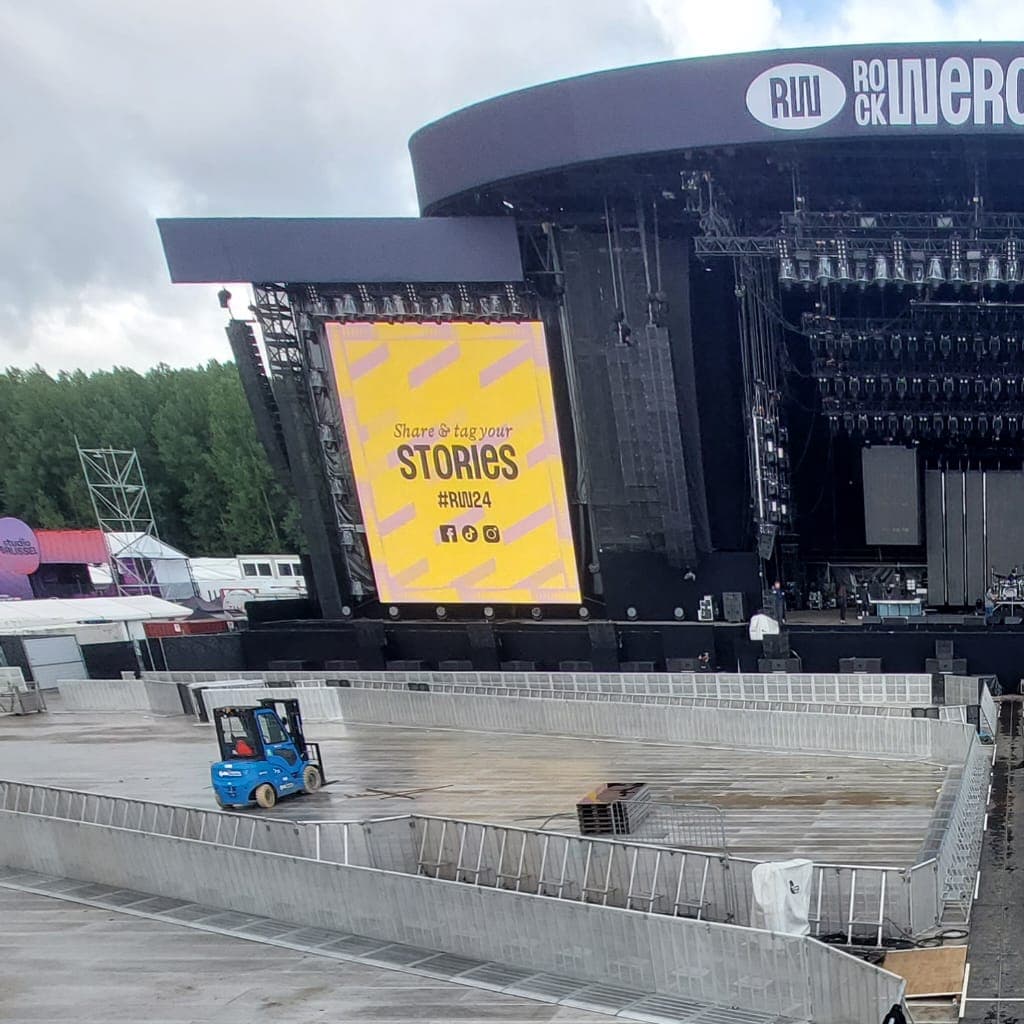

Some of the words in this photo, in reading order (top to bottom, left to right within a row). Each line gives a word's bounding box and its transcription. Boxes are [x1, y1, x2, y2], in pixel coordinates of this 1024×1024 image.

[393, 423, 435, 438] Share
[438, 423, 450, 438] &
[454, 424, 477, 441] tag
[478, 426, 513, 441] your
[438, 491, 492, 508] #RW24
